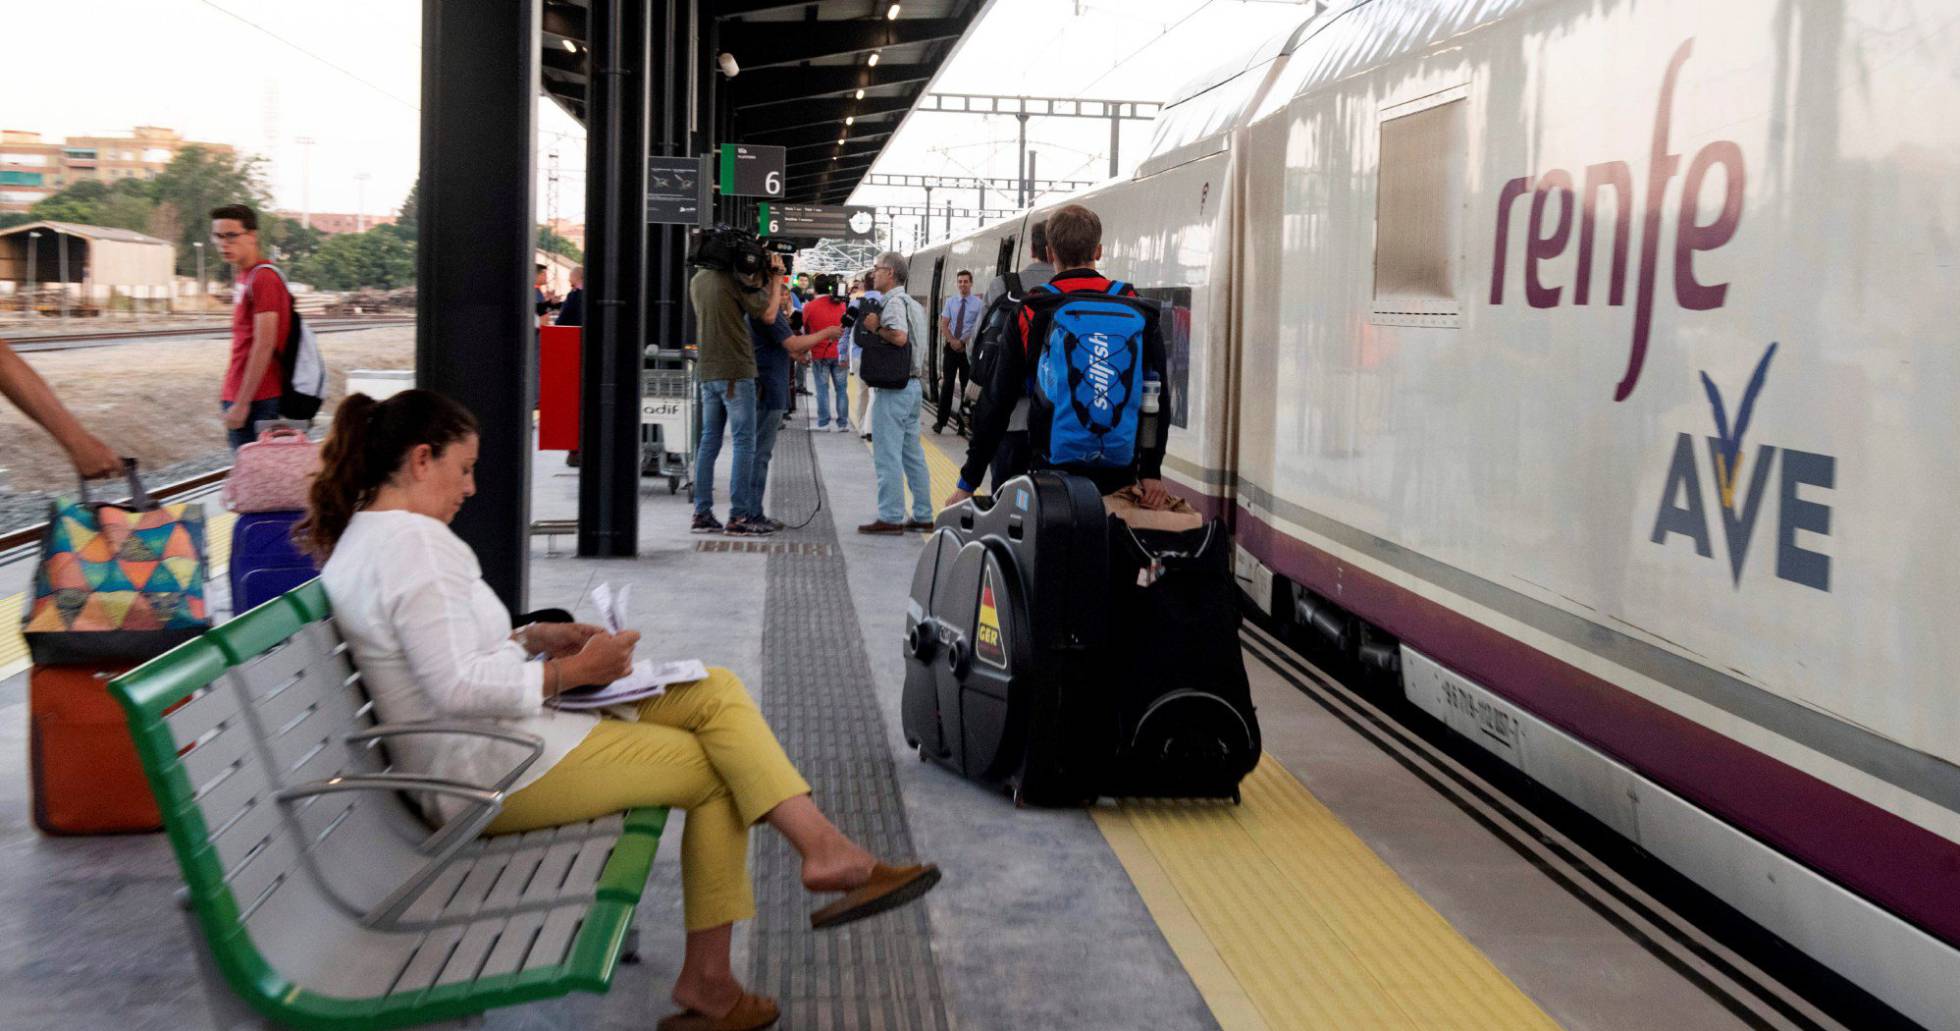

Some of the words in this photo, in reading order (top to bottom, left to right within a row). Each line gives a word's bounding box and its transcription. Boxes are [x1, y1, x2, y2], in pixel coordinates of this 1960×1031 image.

[765, 171, 780, 195] 6
[769, 220, 779, 233] 6
[1489, 37, 1746, 402] renfe
[1650, 432, 1837, 591] AVE
[980, 625, 998, 647] GER
